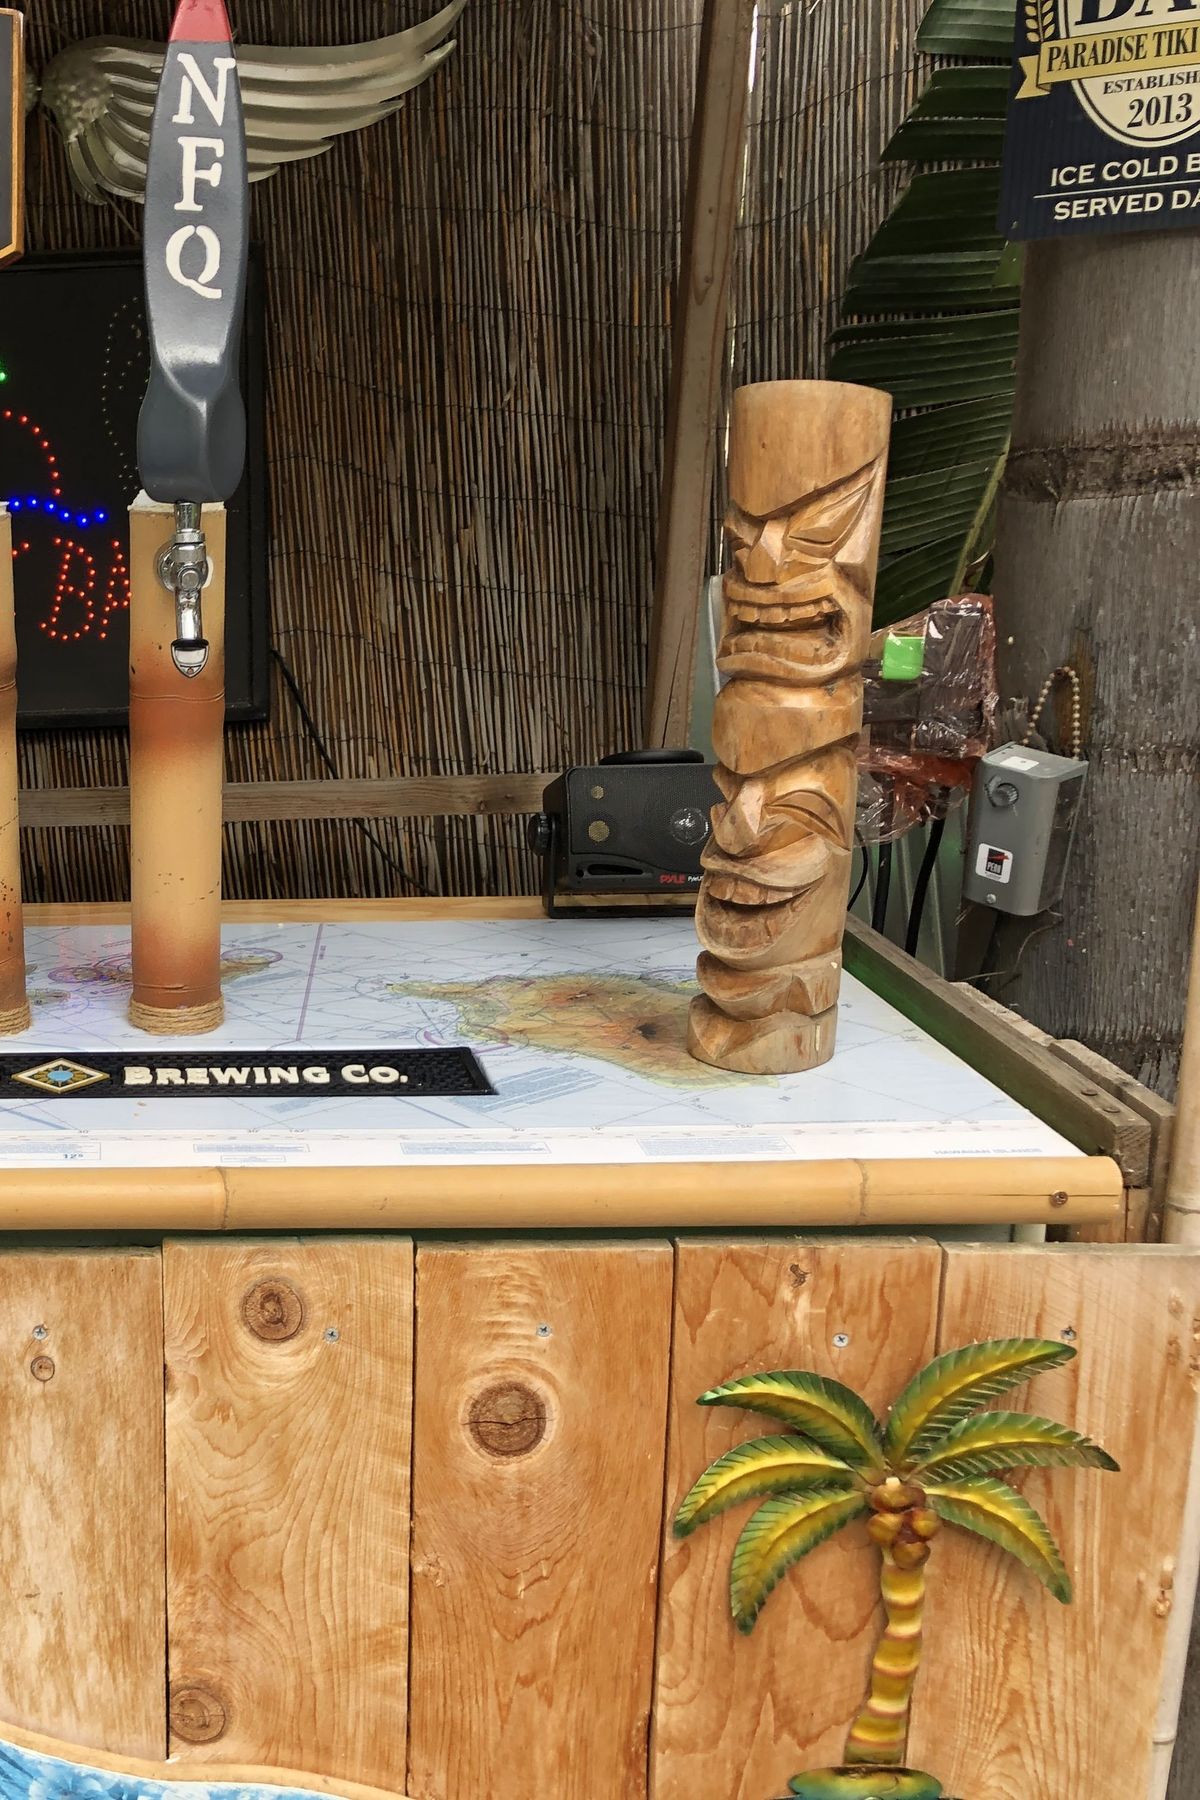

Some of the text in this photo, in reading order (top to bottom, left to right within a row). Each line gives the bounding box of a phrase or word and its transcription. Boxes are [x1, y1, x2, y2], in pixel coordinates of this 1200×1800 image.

[1047, 26, 1199, 72] PARADISE TIKI
[1103, 70, 1200, 95] ESTABLISH
[1127, 93, 1192, 128] 2013
[1050, 163, 1096, 187] ICE
[1101, 155, 1179, 181] COLD
[1053, 192, 1164, 221] SERVED
[123, 1065, 330, 1086] BREWING
